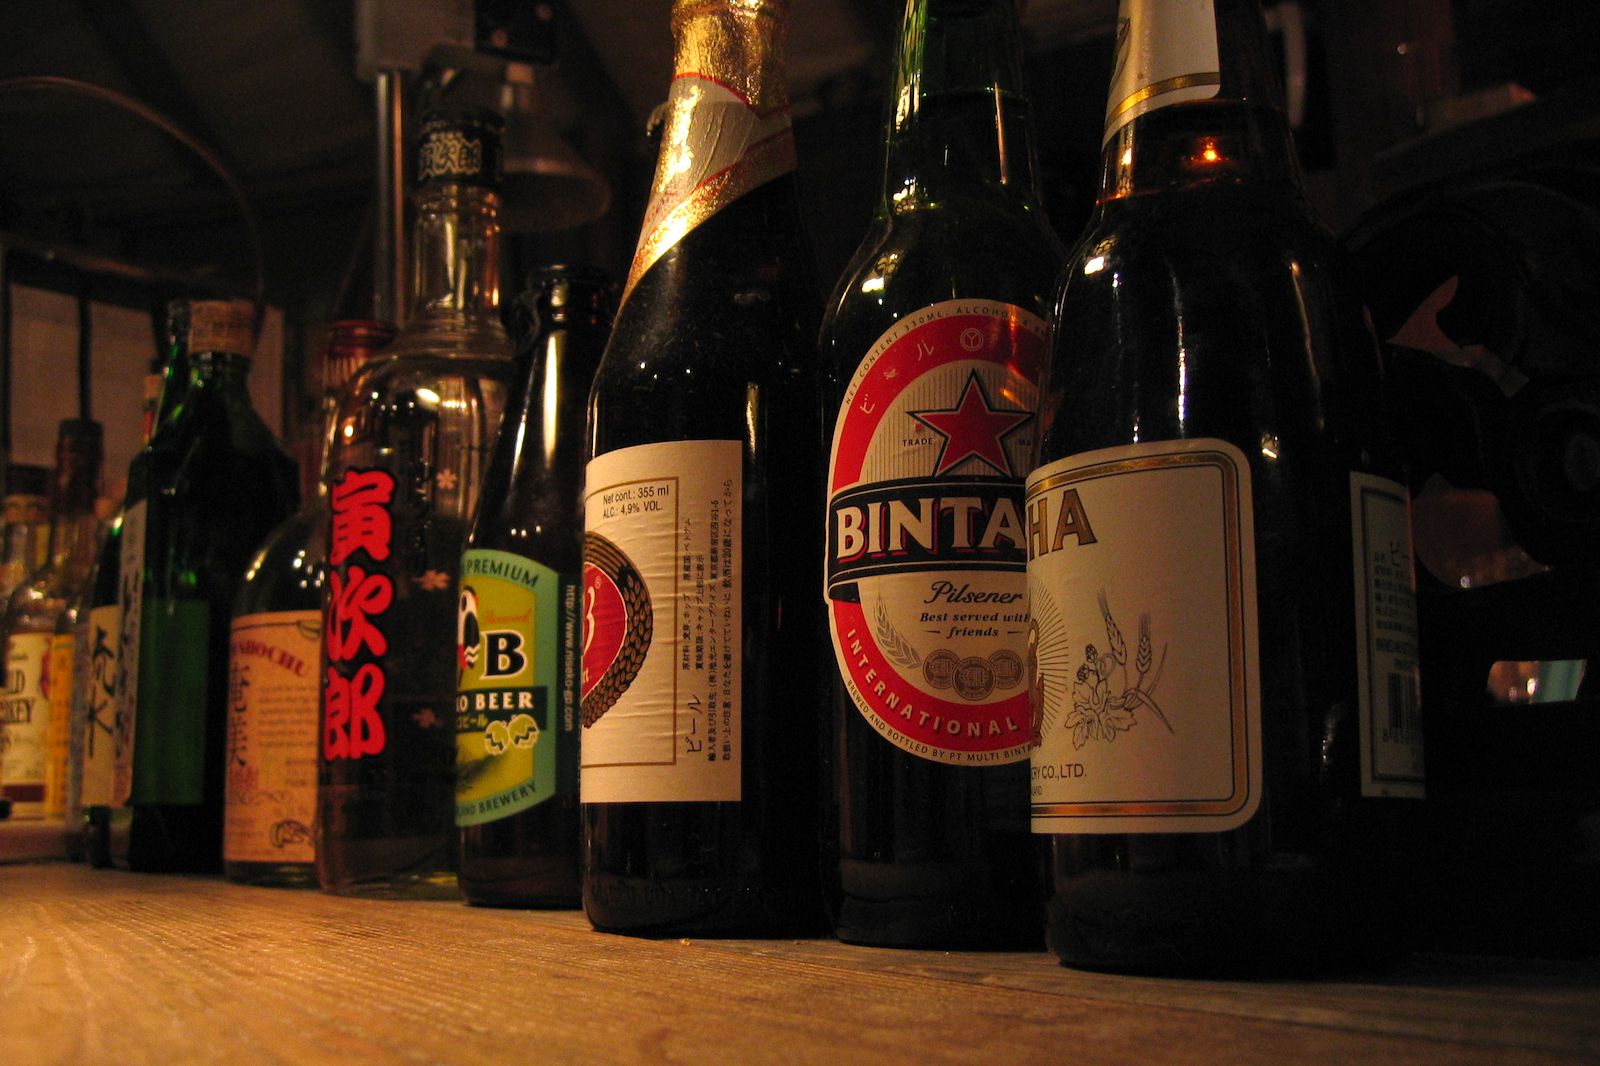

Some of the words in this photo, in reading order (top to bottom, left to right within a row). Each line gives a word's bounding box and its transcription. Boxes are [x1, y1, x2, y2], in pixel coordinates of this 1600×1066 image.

[846, 383, 858, 405] NET
[860, 332, 898, 378] CONTENT
[957, 306, 1014, 319] ALCOHO
[902, 437, 933, 447] TRADE
[602, 492, 614, 505] Net
[637, 486, 655, 499] 355
[657, 484, 669, 496] ml
[620, 502, 641, 516] 4,9%
[466, 559, 539, 588] PREMIUM
[924, 580, 1024, 604] Pilsener
[324, 468, 396, 762] 寅次郎
[921, 612, 948, 622] Best
[952, 612, 999, 622] served
[946, 626, 999, 640] friends
[847, 628, 1019, 738] INTERNATIONAL
[474, 691, 534, 711] BEER
[685, 694, 703, 754] ビール
[847, 679, 869, 713] BREWED
[869, 714, 886, 730] AND
[887, 728, 928, 754] BOTTLED
[932, 750, 945, 758] BY
[949, 753, 962, 761] PT
[967, 753, 1000, 761] MULTI
[479, 780, 536, 814] BREWERY
